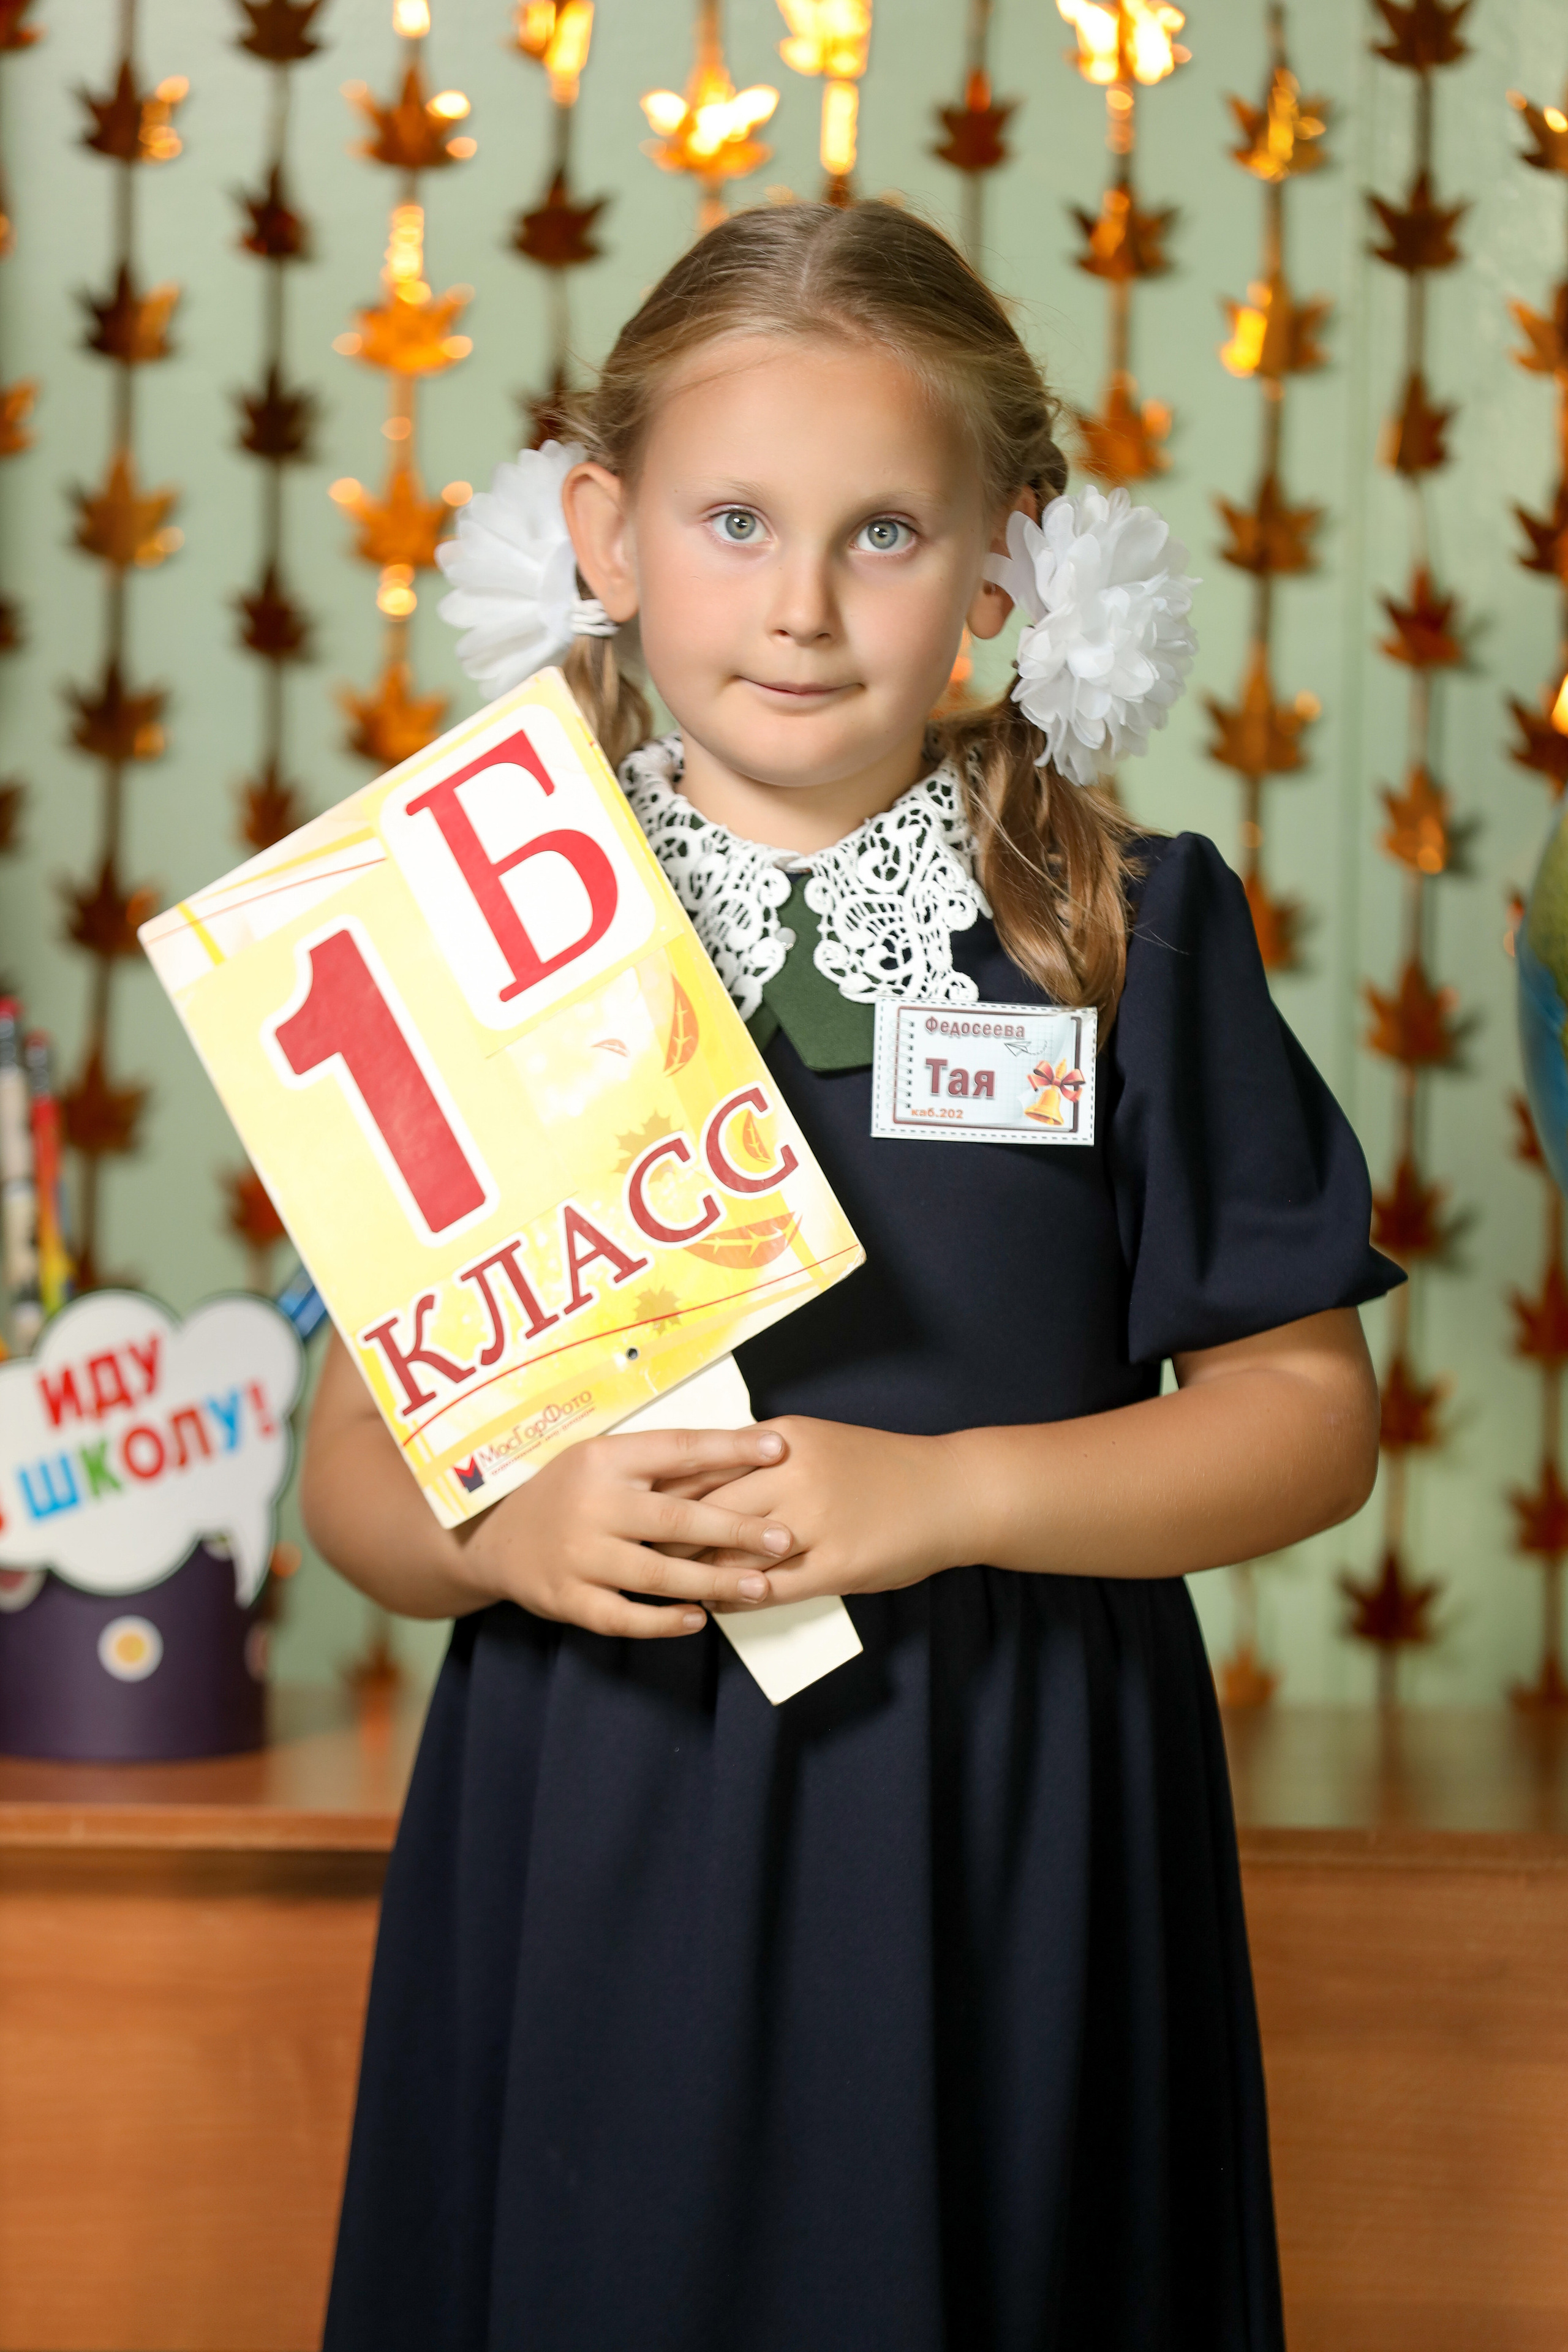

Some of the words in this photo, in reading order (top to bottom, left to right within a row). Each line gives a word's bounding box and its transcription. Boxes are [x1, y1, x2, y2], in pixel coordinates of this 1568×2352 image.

[275, 929, 486, 1233] 1
[405, 729, 619, 1003] Б
[924, 1016, 1026, 1039] Федосеева
[910, 1107, 964, 1120] каб.202
[925, 1057, 996, 1098] Тая
[363, 1087, 799, 1417] КЛАСС
[37, 1333, 164, 1431] ИДУ
[18, 1378, 278, 1521] ШКОЛУ!
[478, 1390, 592, 1468] МосГорФото
